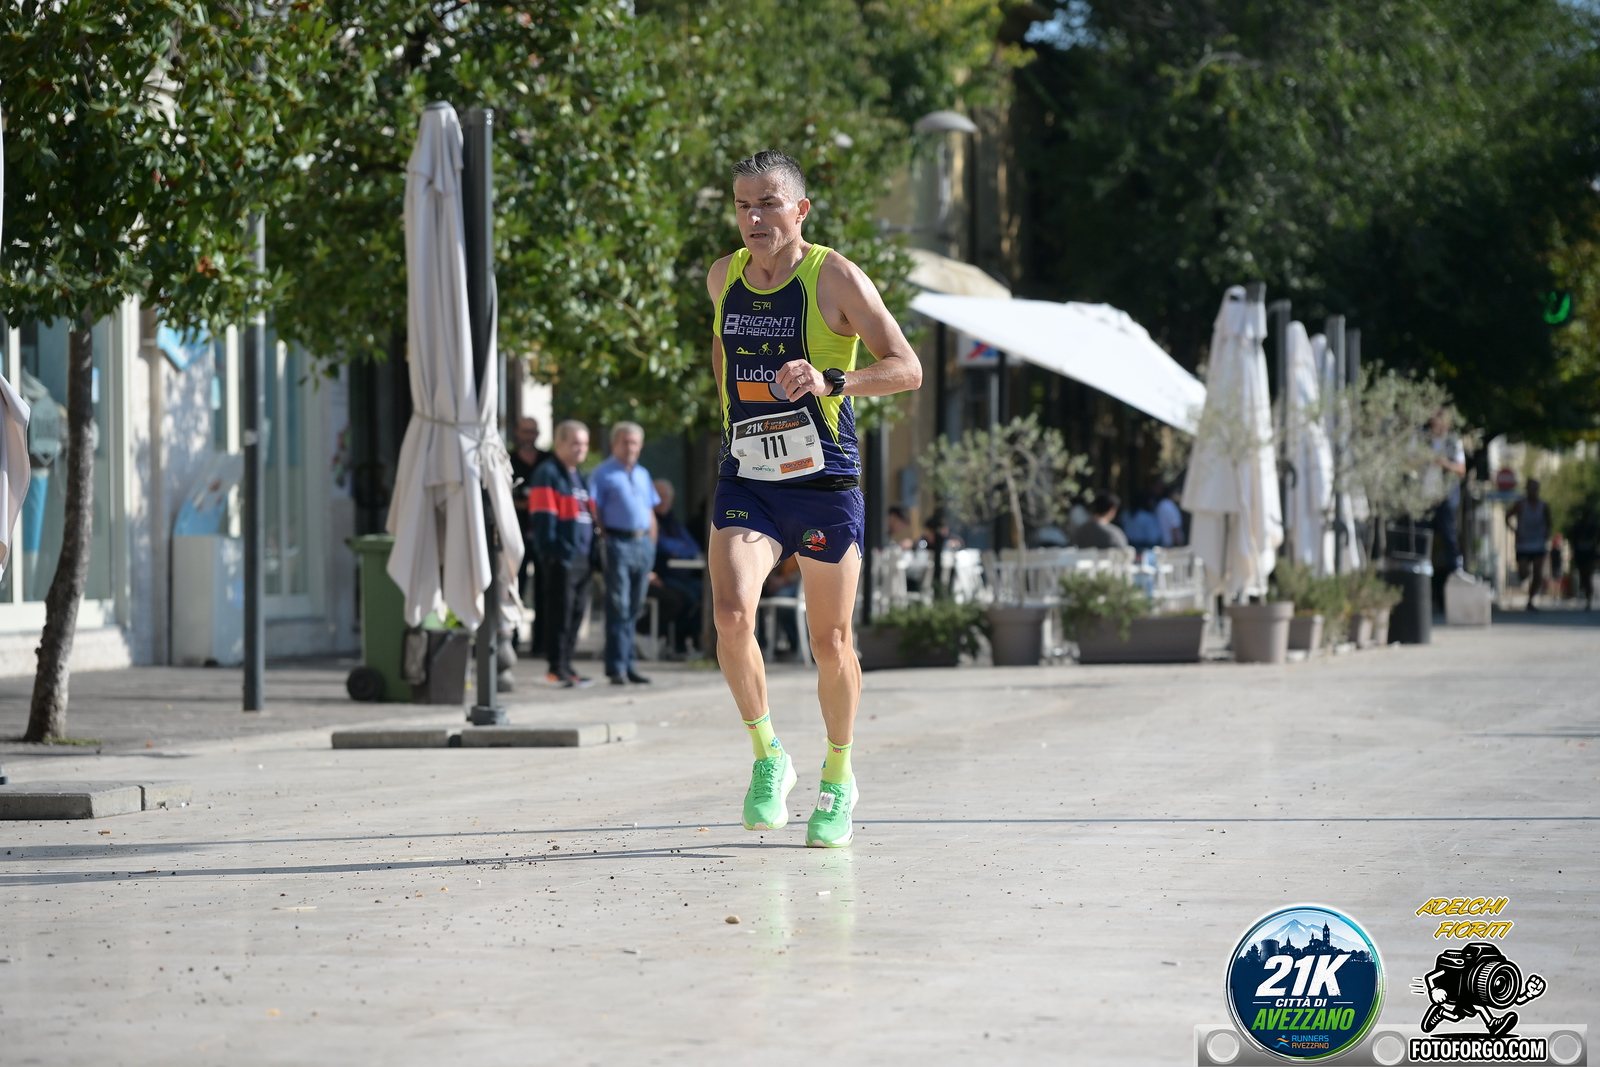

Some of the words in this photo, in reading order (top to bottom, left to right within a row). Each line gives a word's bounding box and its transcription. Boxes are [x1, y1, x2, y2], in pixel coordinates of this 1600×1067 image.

[723, 313, 796, 334] BRIGANTI
[736, 364, 780, 381] Ludo
[745, 423, 763, 434] 21K
[761, 434, 787, 459] 111
